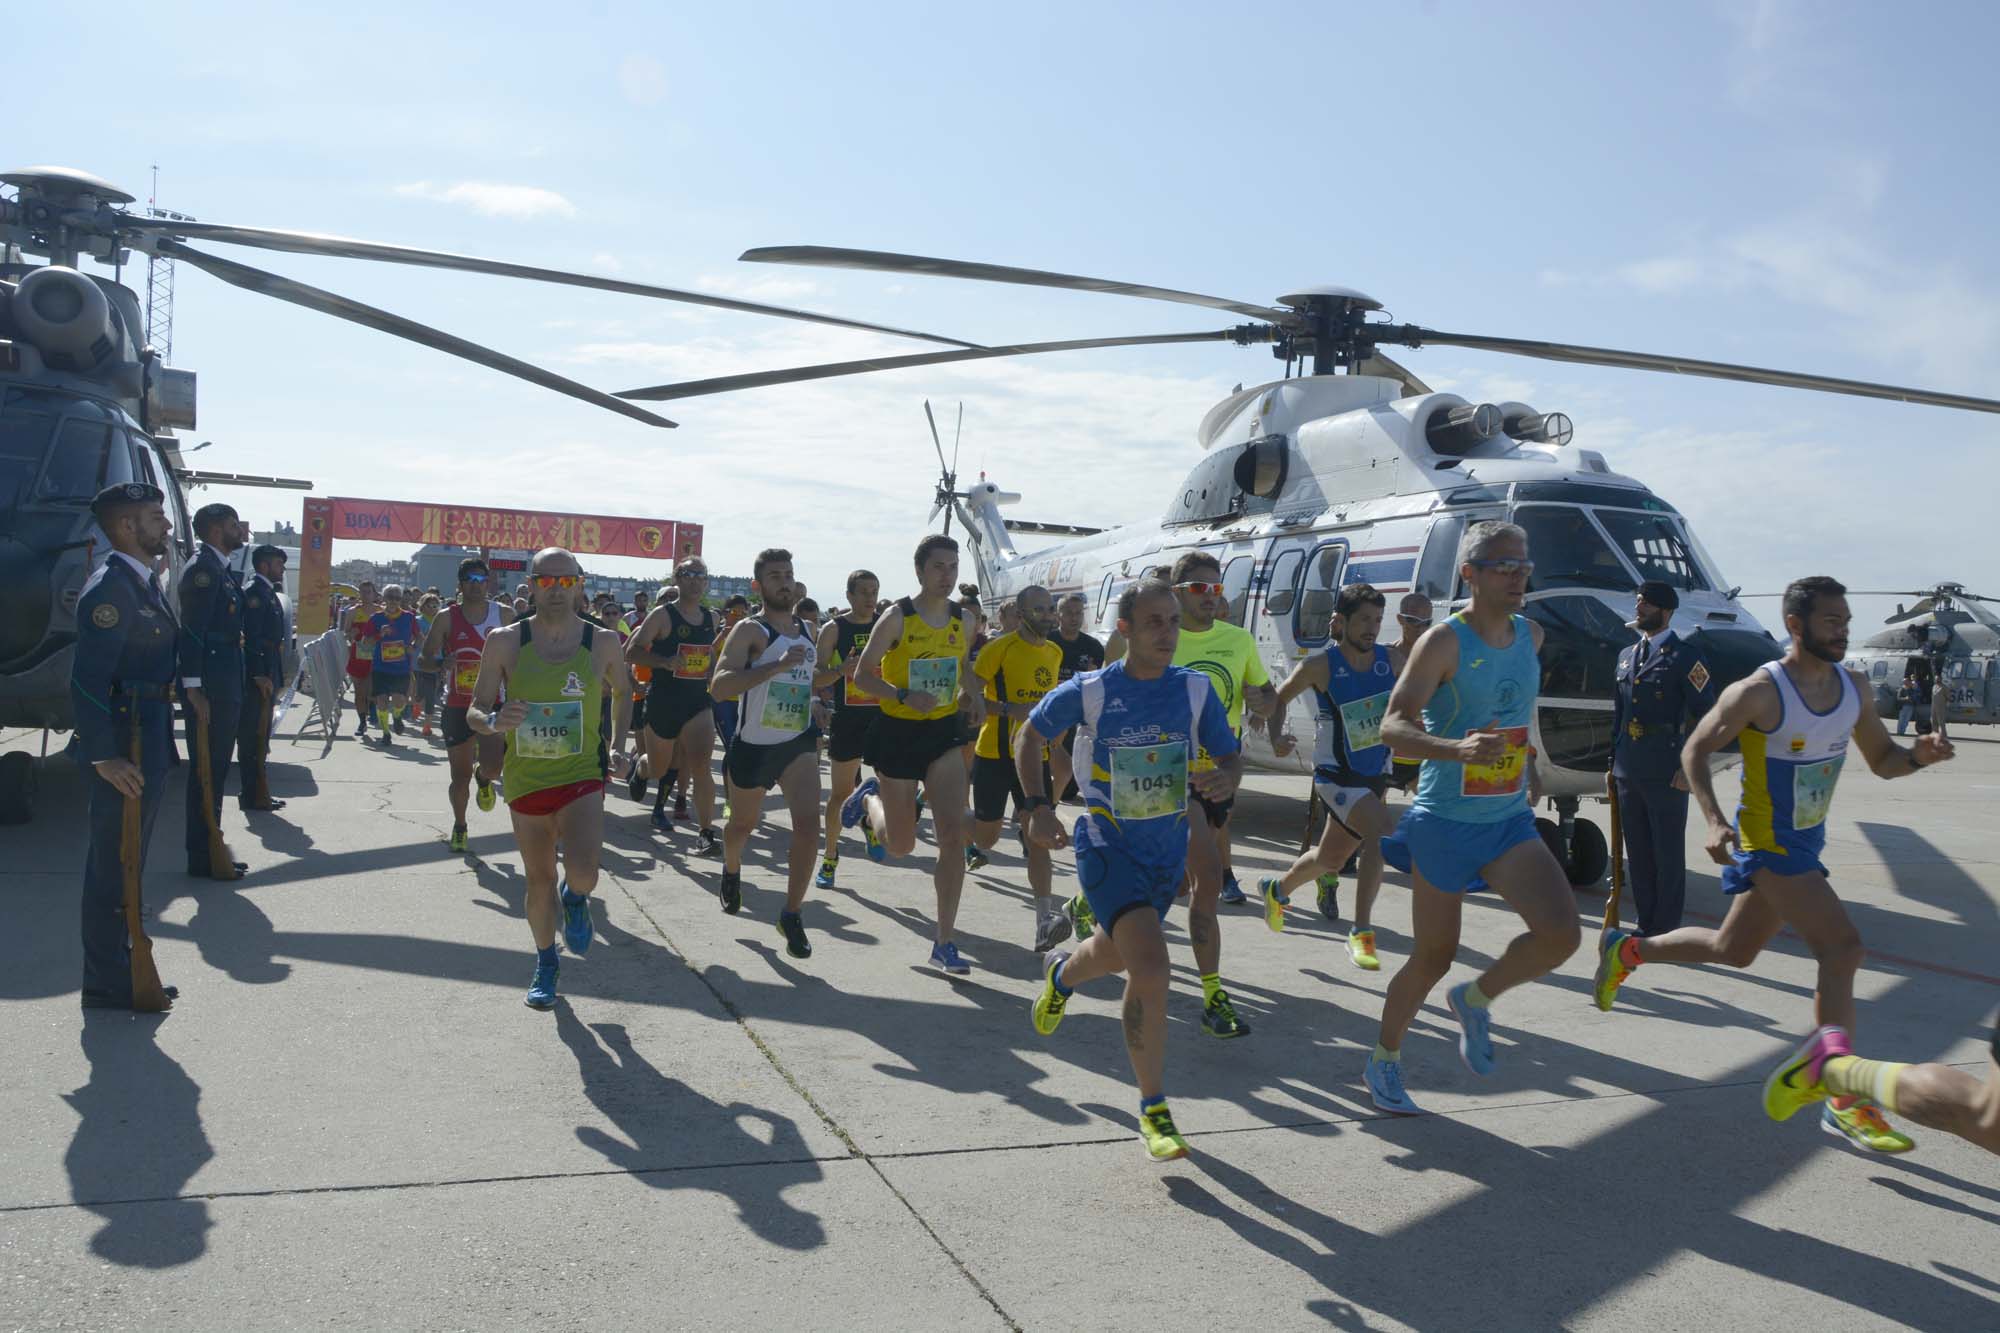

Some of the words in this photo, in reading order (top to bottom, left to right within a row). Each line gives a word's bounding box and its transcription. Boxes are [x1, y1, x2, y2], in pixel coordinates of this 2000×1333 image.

[345, 512, 392, 529] BBVA
[444, 510, 541, 531] CARRERA
[444, 527, 546, 549] SOLIDARIA
[555, 518, 601, 552] 48
[922, 680, 950, 689] 1142
[530, 726, 568, 738] 1106
[1121, 725, 1160, 737] CLUB
[1131, 773, 1175, 793] 1043
